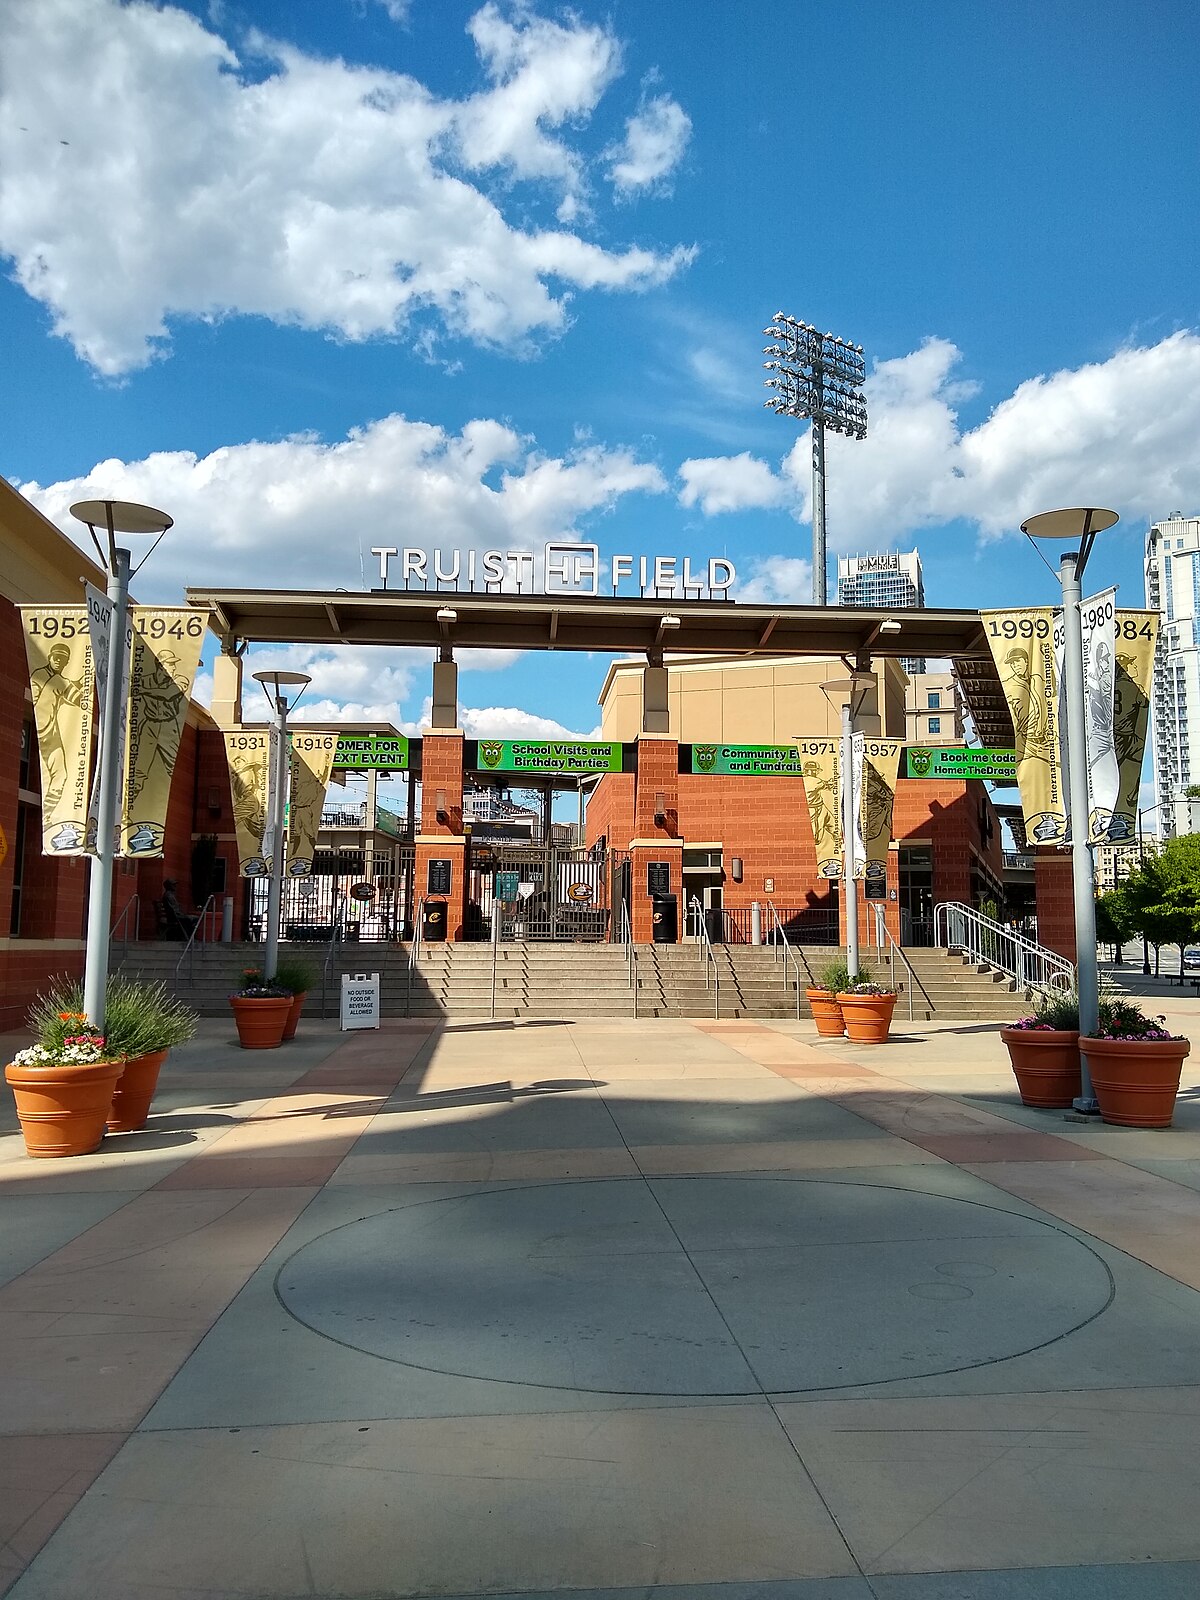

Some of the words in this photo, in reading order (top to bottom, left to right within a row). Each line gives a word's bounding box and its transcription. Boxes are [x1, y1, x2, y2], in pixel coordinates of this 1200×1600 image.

[371, 546, 534, 585] TRUIST
[612, 555, 736, 590] FIELD
[29, 617, 90, 638] 1952
[1082, 602, 1113, 631] 1980
[137, 617, 203, 640] 1946
[989, 618, 1050, 639] 1999
[80, 644, 92, 710] Champions
[134, 646, 145, 696] Tri-State
[1044, 643, 1053, 697] Champions
[129, 697, 142, 741] League
[1047, 702, 1055, 742] League
[78, 714, 89, 758] League
[229, 737, 266, 750] 1931
[295, 737, 333, 751] 1916
[336, 741, 373, 751] OMER
[375, 741, 399, 751] FOR
[333, 754, 358, 763] EXT
[362, 754, 405, 763] EVENT
[512, 744, 551, 755] School
[554, 745, 588, 756] Visits
[590, 746, 612, 756] and
[721, 749, 786, 761] Community
[801, 743, 836, 755] 1971
[863, 743, 898, 756] 1957
[940, 753, 969, 762] Book
[991, 753, 1016, 762] toda
[260, 751, 268, 791] Champions
[514, 757, 564, 769] Birthday
[568, 758, 609, 768] Parties
[729, 761, 751, 771] and
[753, 762, 802, 772] Fundrais
[934, 766, 1016, 776] HomerTheDrago
[1049, 743, 1058, 804] International
[74, 760, 86, 810] Tri-State
[126, 743, 139, 811] Champions
[259, 792, 267, 818] League
